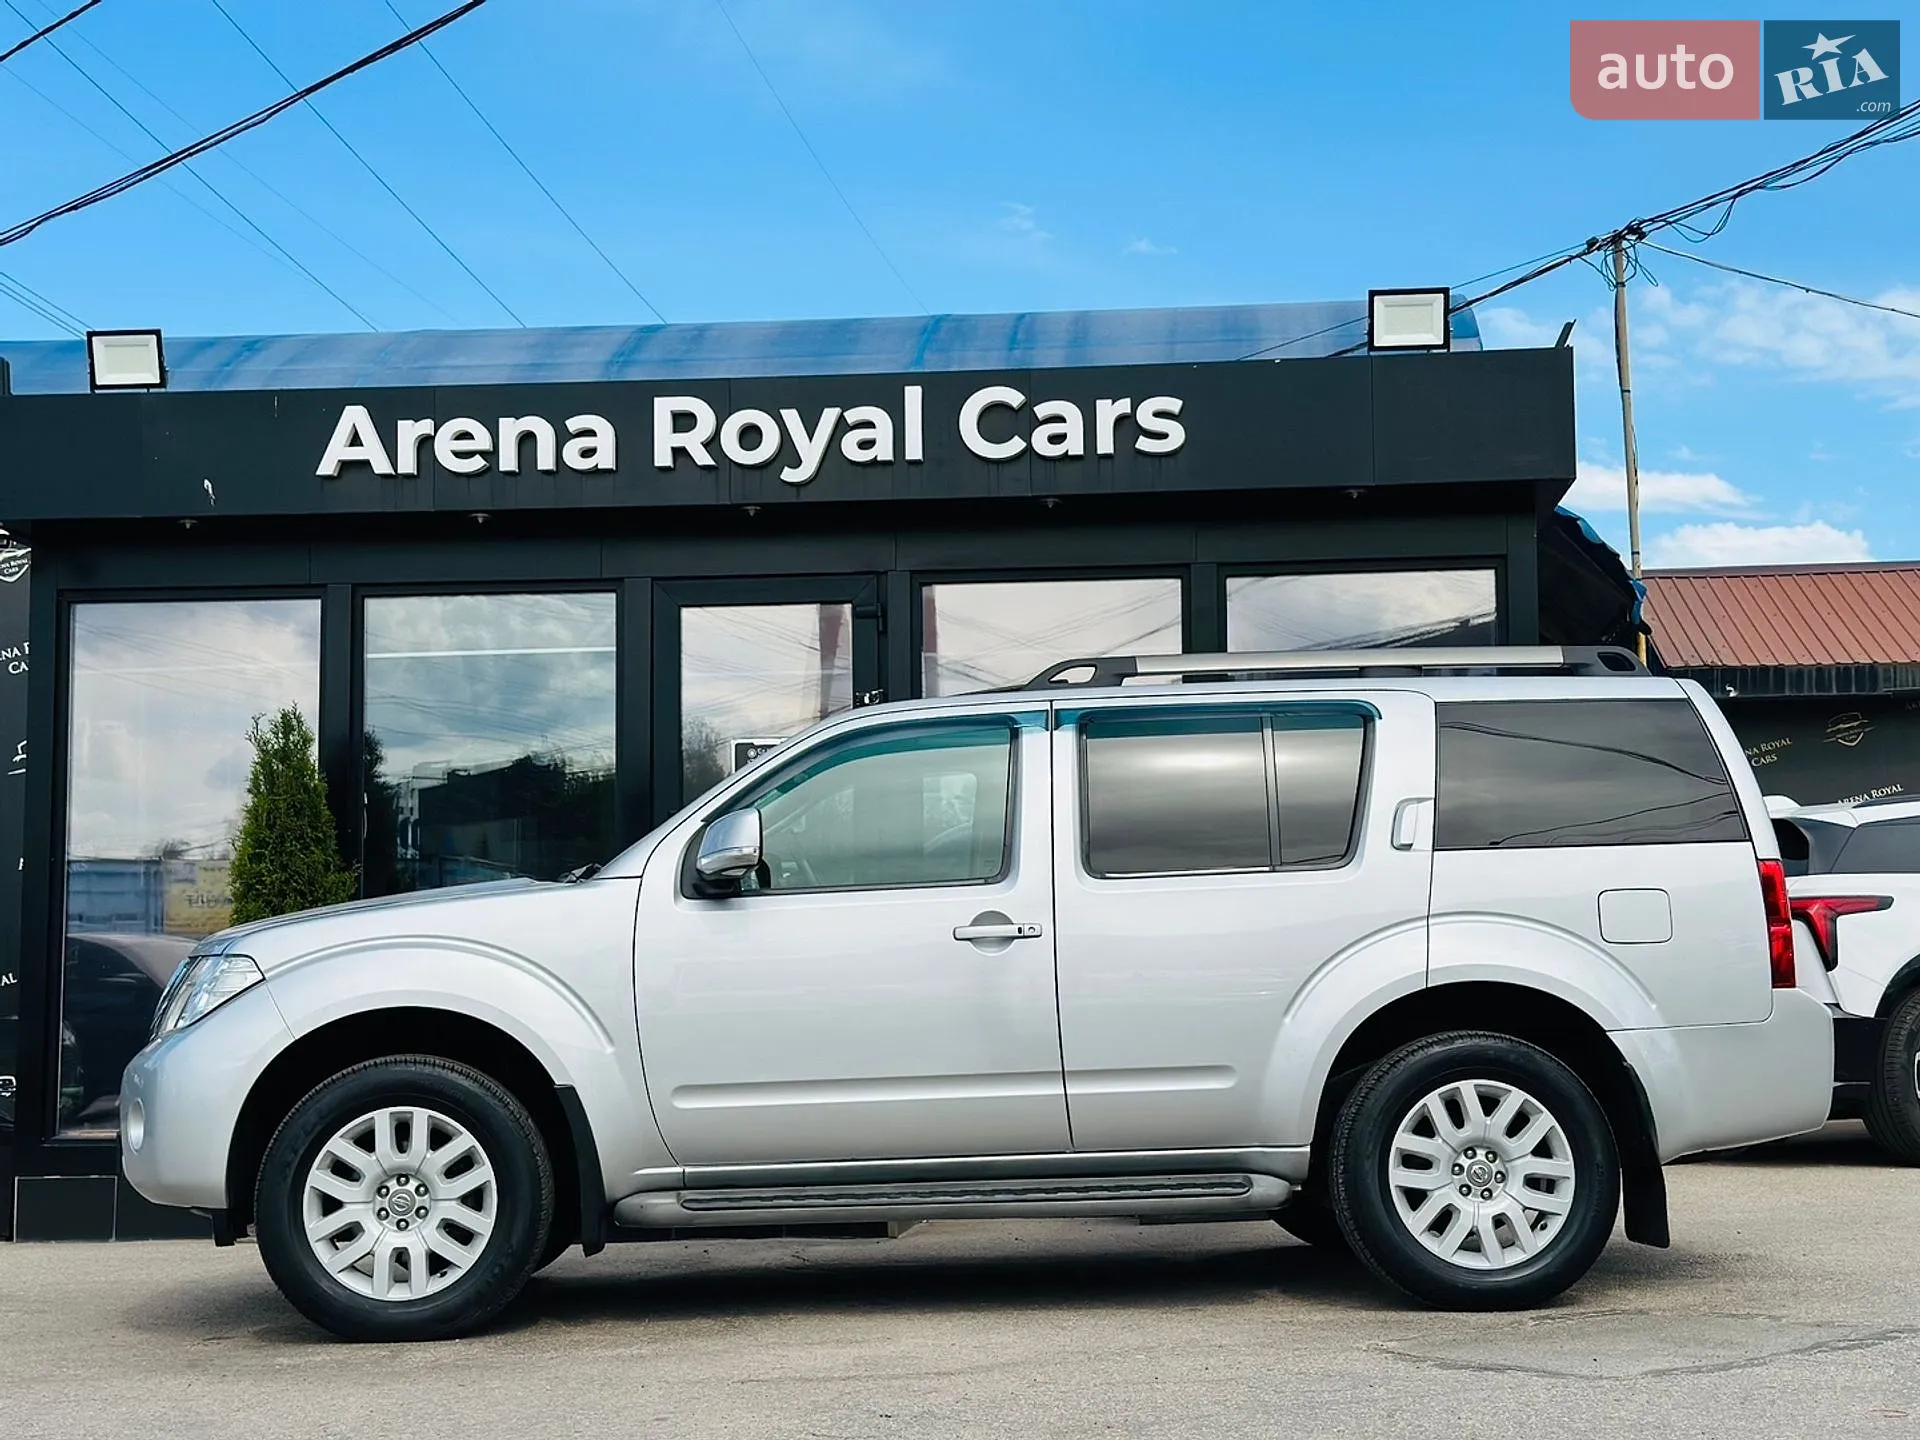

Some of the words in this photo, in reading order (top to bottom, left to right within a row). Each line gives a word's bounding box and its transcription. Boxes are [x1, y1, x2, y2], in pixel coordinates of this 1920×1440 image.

[315, 404, 616, 477] Arena
[653, 385, 924, 484] Royal
[958, 385, 1187, 459] Cars
[1760, 737, 1793, 752] ROYAL
[1751, 753, 1778, 767] CARS
[1870, 783, 1904, 799] ROYAL
